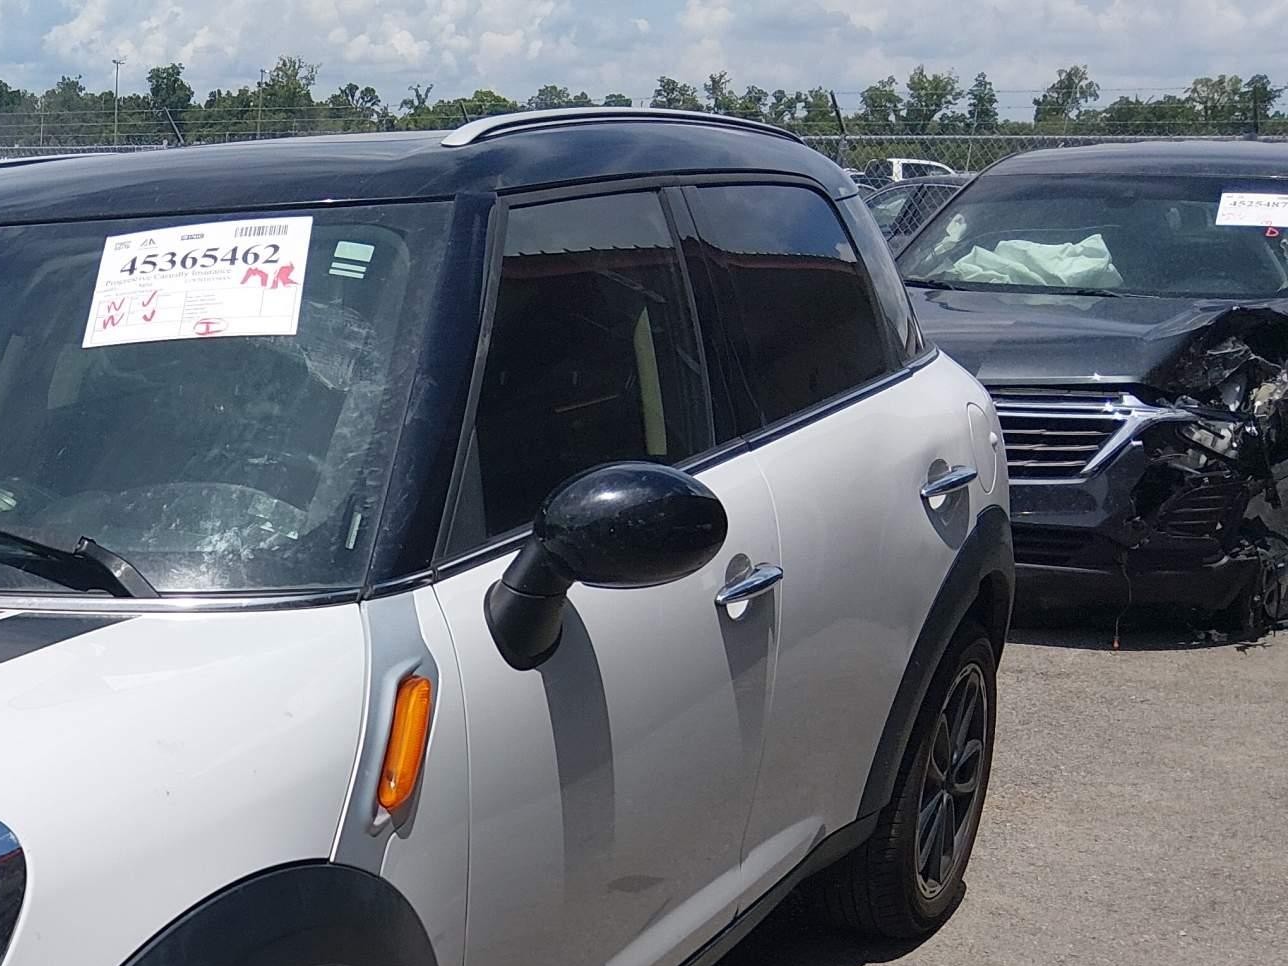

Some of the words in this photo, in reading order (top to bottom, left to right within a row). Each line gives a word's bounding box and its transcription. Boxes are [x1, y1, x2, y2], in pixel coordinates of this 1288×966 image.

[120, 243, 280, 276] 45365462
[105, 274, 152, 288] Progressive
[192, 267, 232, 276] Insurance
